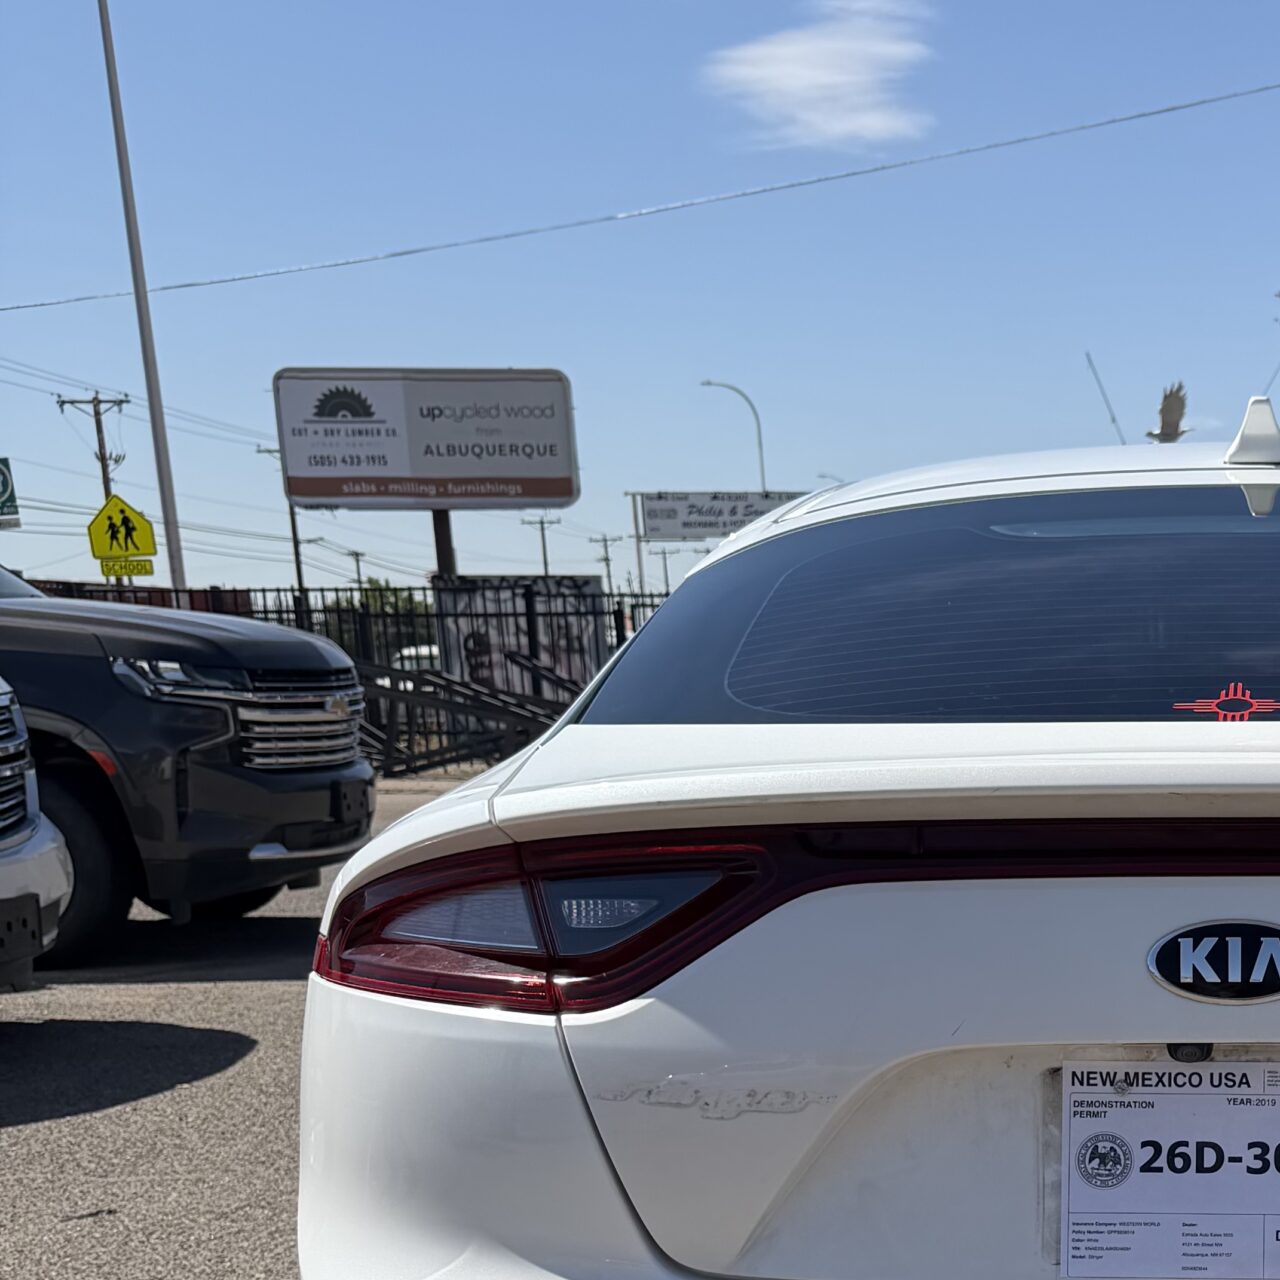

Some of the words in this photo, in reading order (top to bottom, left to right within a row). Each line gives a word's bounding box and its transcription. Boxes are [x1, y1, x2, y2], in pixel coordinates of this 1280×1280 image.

[419, 403, 499, 422] upcycled
[505, 403, 555, 419] wood
[423, 443, 559, 460] ALBUQUERQUE
[308, 454, 337, 467] (505)
[342, 481, 377, 493] slabs
[388, 481, 436, 496] milling
[448, 482, 522, 496] furnishings
[687, 504, 724, 518] Philip
[104, 562, 149, 574] SCHOOL
[1071, 1071, 1117, 1087] NEW
[1124, 1071, 1203, 1088] MEXICO
[1209, 1072, 1251, 1088] USA
[1073, 1100, 1154, 1109] DEMONSTRATION
[1073, 1110, 1107, 1118] PERMIT
